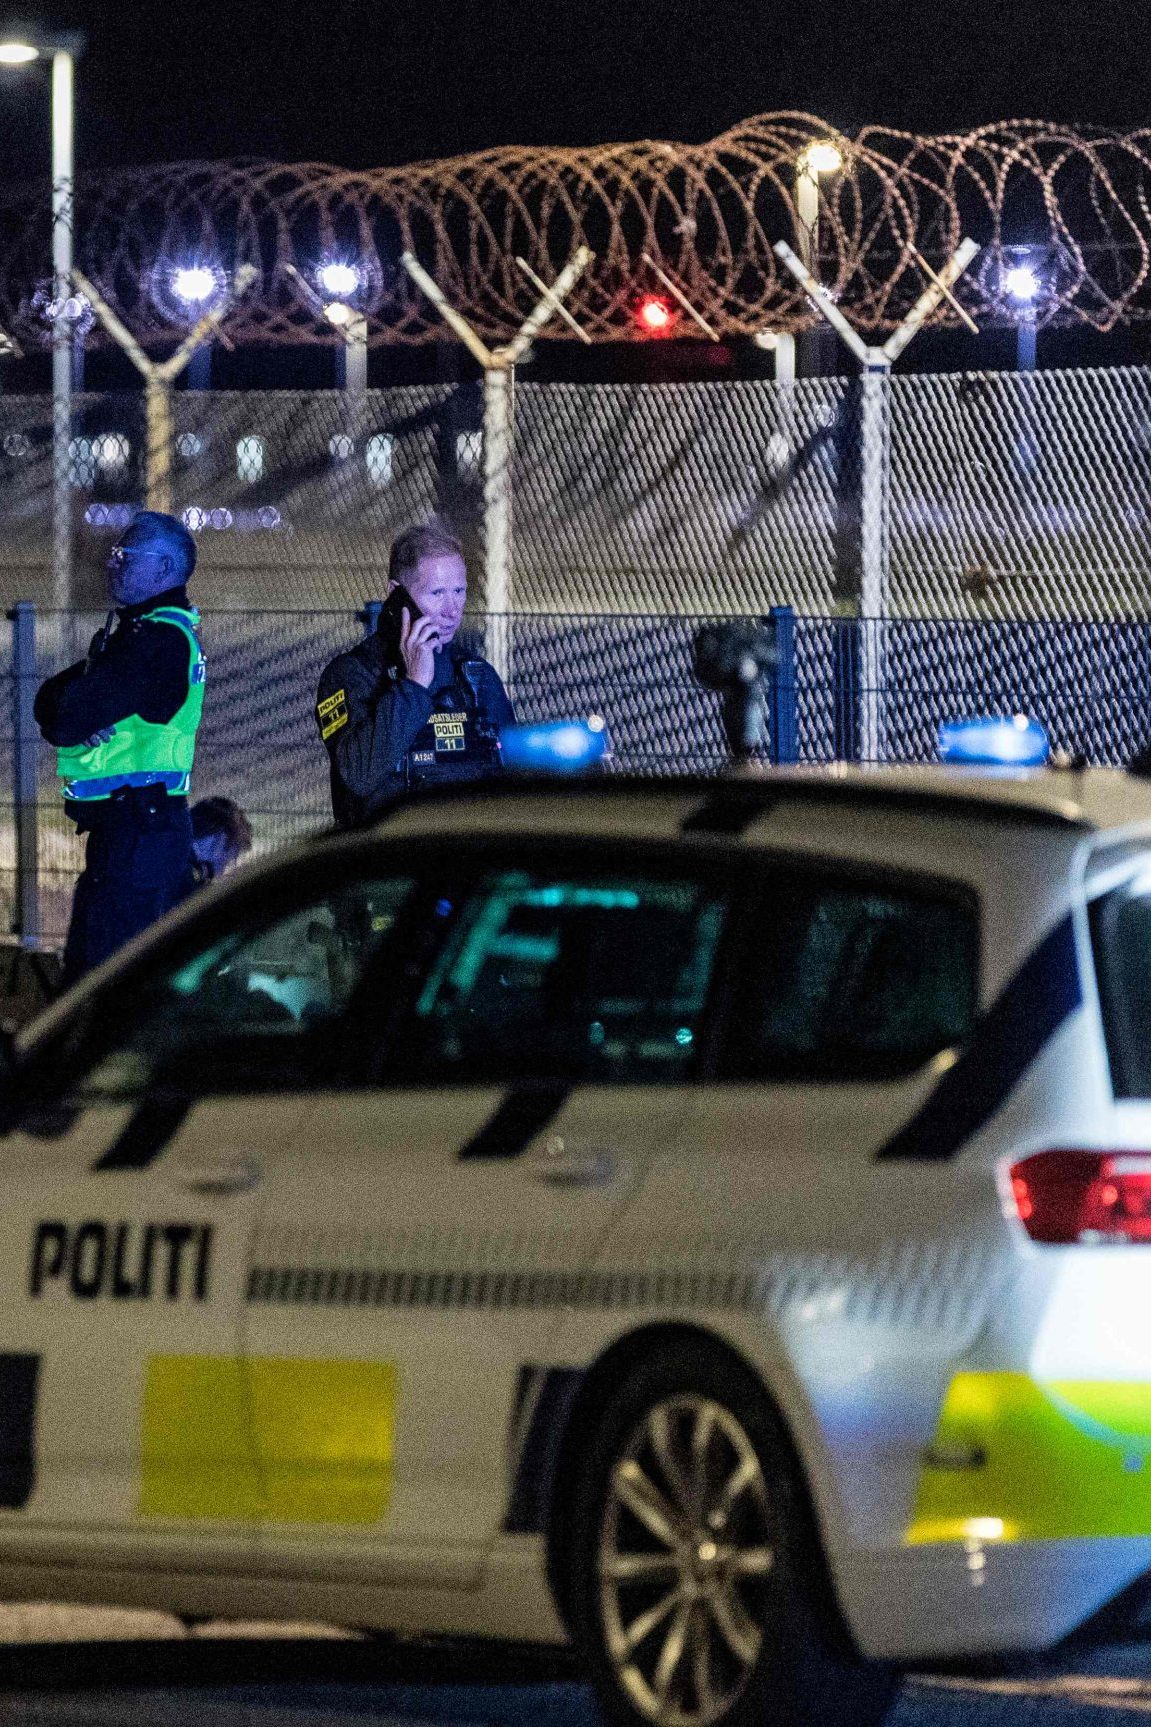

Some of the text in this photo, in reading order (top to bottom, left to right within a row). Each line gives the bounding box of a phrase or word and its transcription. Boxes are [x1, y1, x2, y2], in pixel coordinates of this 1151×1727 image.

[320, 692, 343, 713] POLITI
[328, 708, 340, 720] 11
[435, 724, 462, 735] POLITI
[445, 739, 456, 750] 11
[30, 1221, 214, 1301] POLITI
